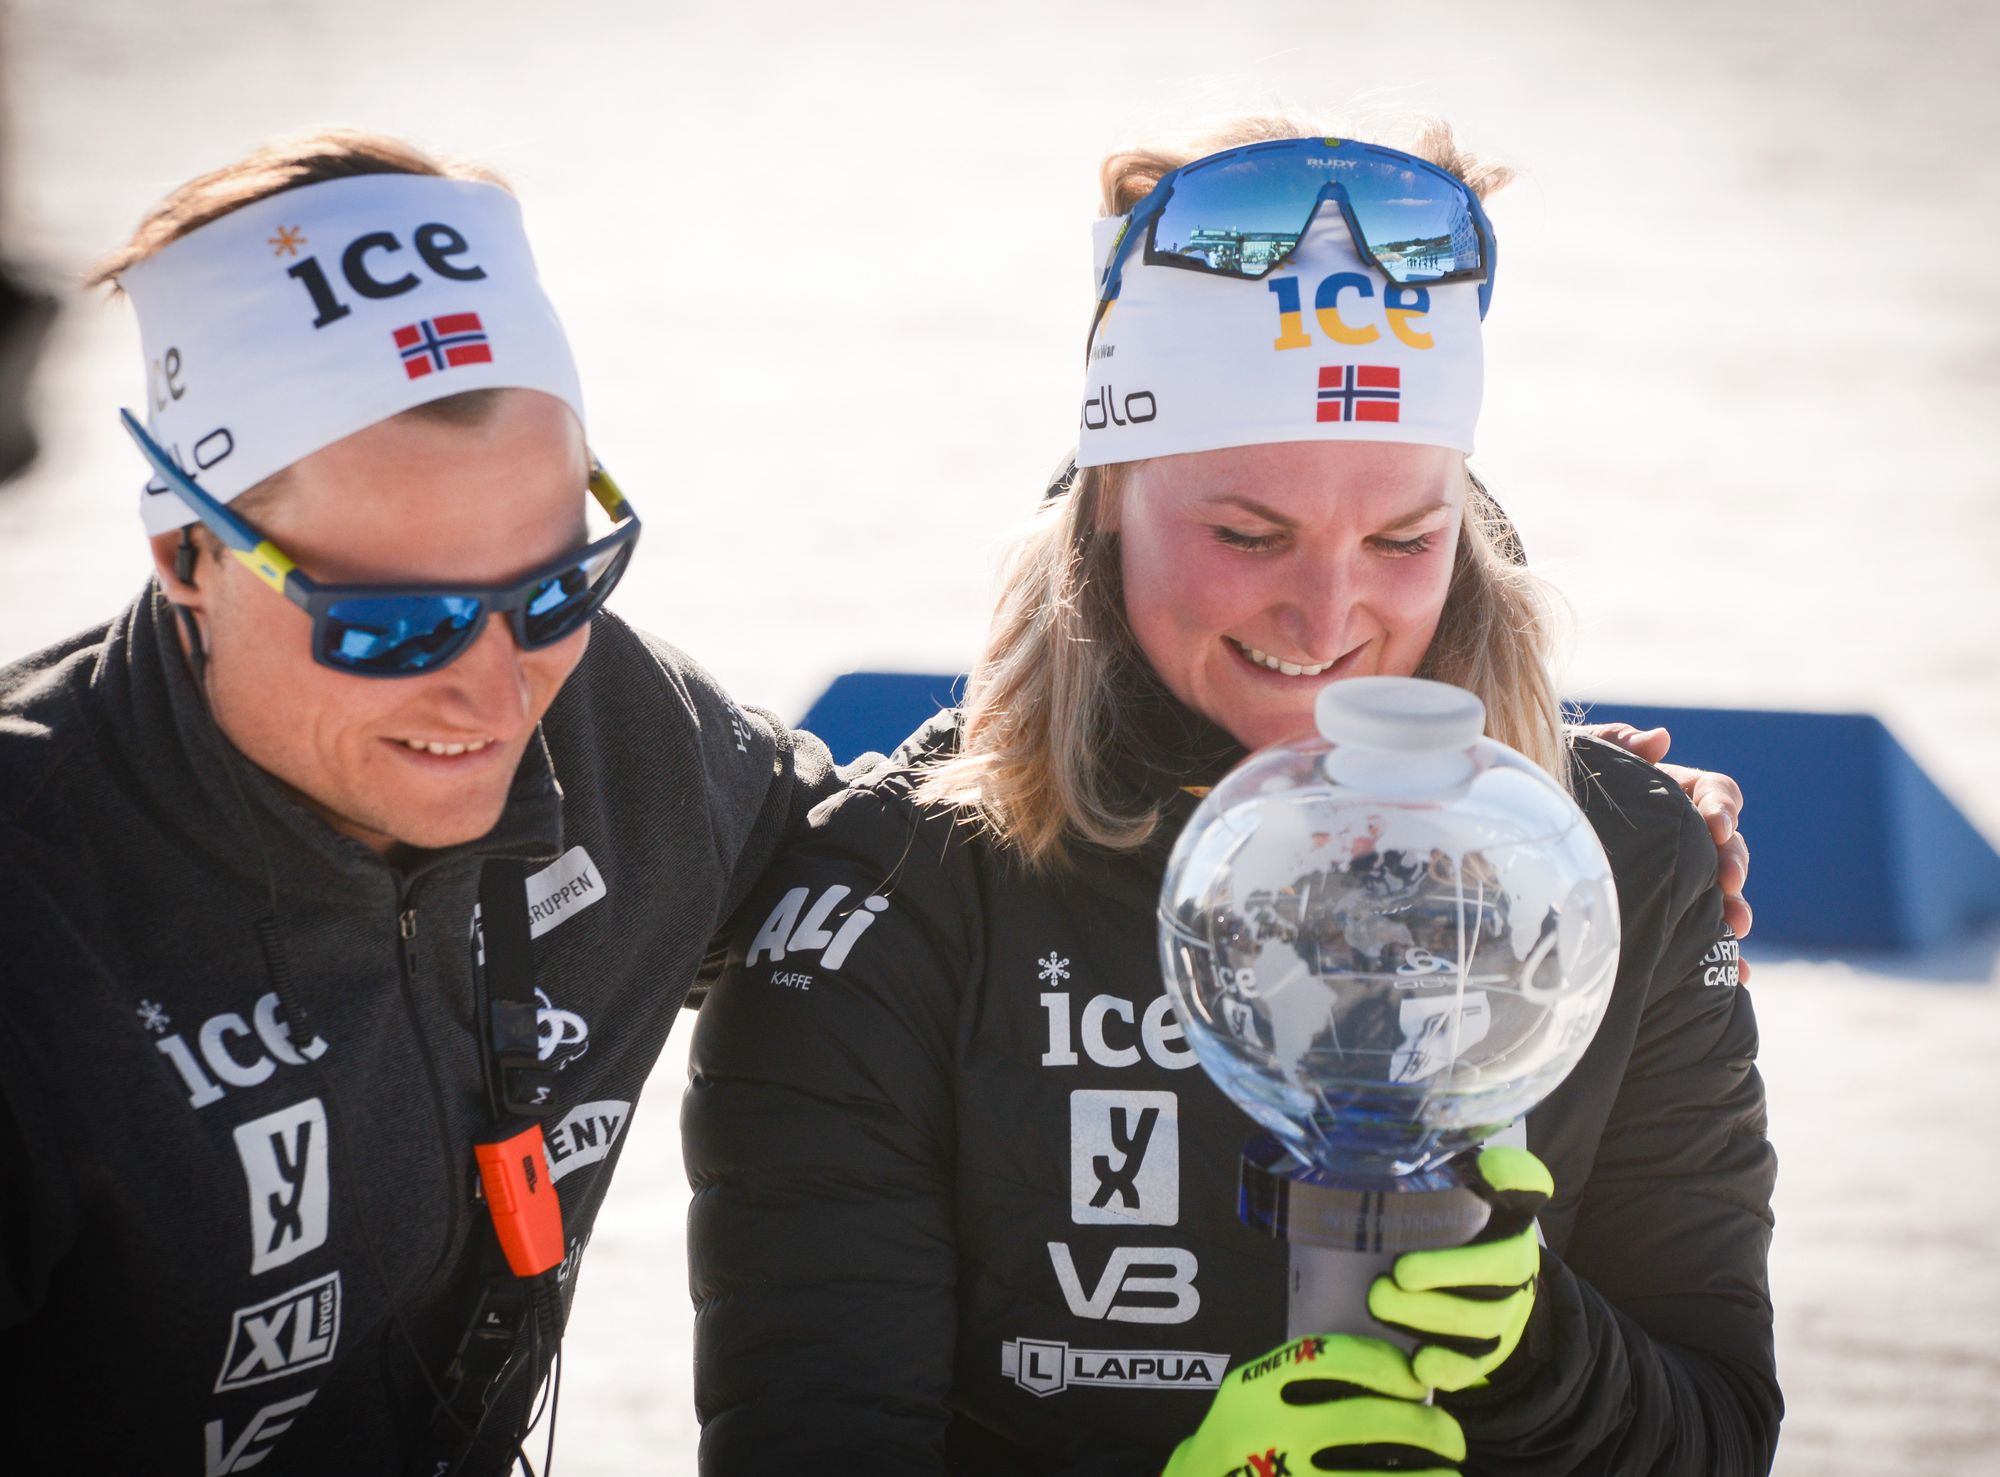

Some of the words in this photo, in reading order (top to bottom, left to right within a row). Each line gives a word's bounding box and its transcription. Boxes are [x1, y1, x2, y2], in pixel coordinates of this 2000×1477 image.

[1306, 158, 1358, 168] RUDY
[287, 222, 487, 330] ice
[1269, 271, 1435, 351] ice
[1080, 384, 1157, 430] dlo
[770, 970, 813, 991] KAFFE
[1040, 992, 1200, 1070] ice
[545, 1114, 620, 1164] ENY
[1047, 1241, 1201, 1325] VB
[226, 1295, 331, 1381] XL
[1029, 1352, 1053, 1380] L
[1074, 1356, 1213, 1382] LAPUA
